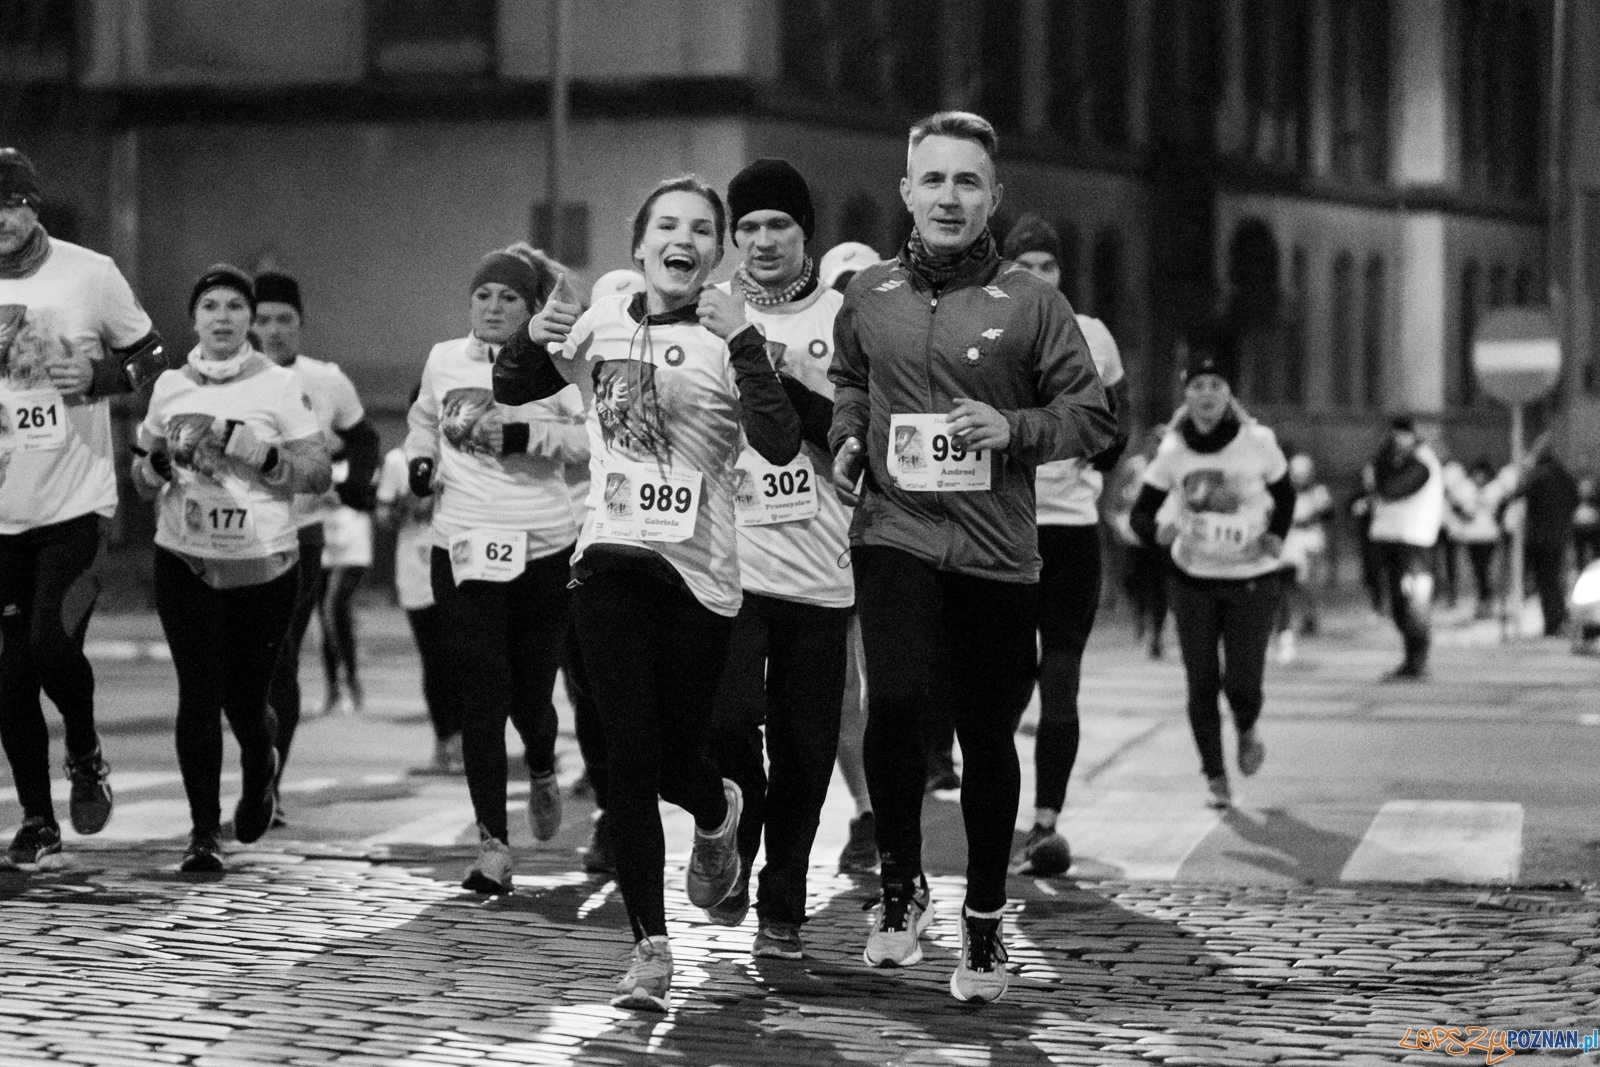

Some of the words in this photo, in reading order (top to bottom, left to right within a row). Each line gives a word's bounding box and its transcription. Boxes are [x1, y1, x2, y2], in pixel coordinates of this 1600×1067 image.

[17, 404, 57, 429] 261
[762, 468, 811, 497] 302
[639, 483, 692, 513] 989
[209, 507, 247, 529] 177
[644, 517, 680, 527] Gabriela
[486, 542, 513, 562] 62
